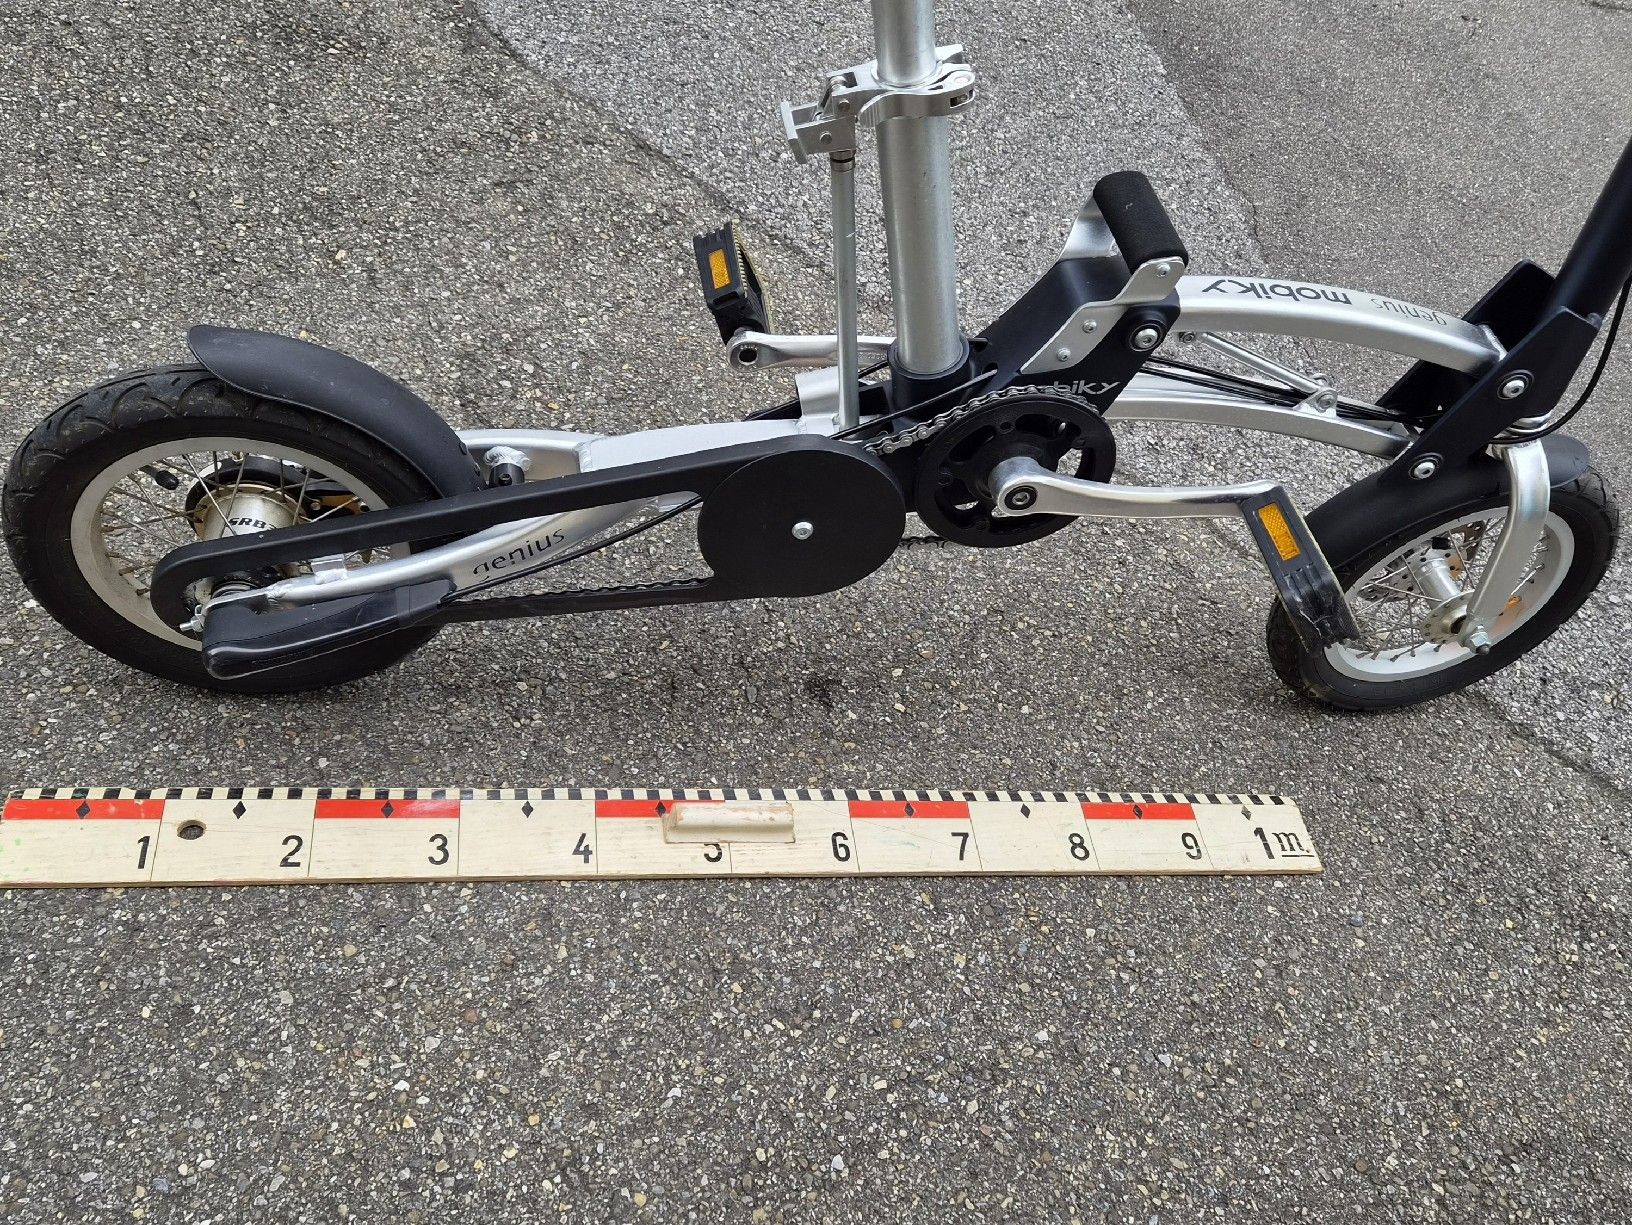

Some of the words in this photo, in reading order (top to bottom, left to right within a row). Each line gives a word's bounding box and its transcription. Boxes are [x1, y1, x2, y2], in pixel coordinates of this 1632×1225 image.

[1370, 298, 1448, 326] genius
[1053, 379, 1120, 395] biky
[137, 835, 151, 870] 1
[279, 834, 303, 868] 2
[428, 833, 450, 866] 3
[572, 832, 593, 864] 4
[831, 831, 851, 862] 6
[951, 832, 970, 861] 7
[1068, 832, 1090, 861] 8
[1181, 832, 1200, 860] 9
